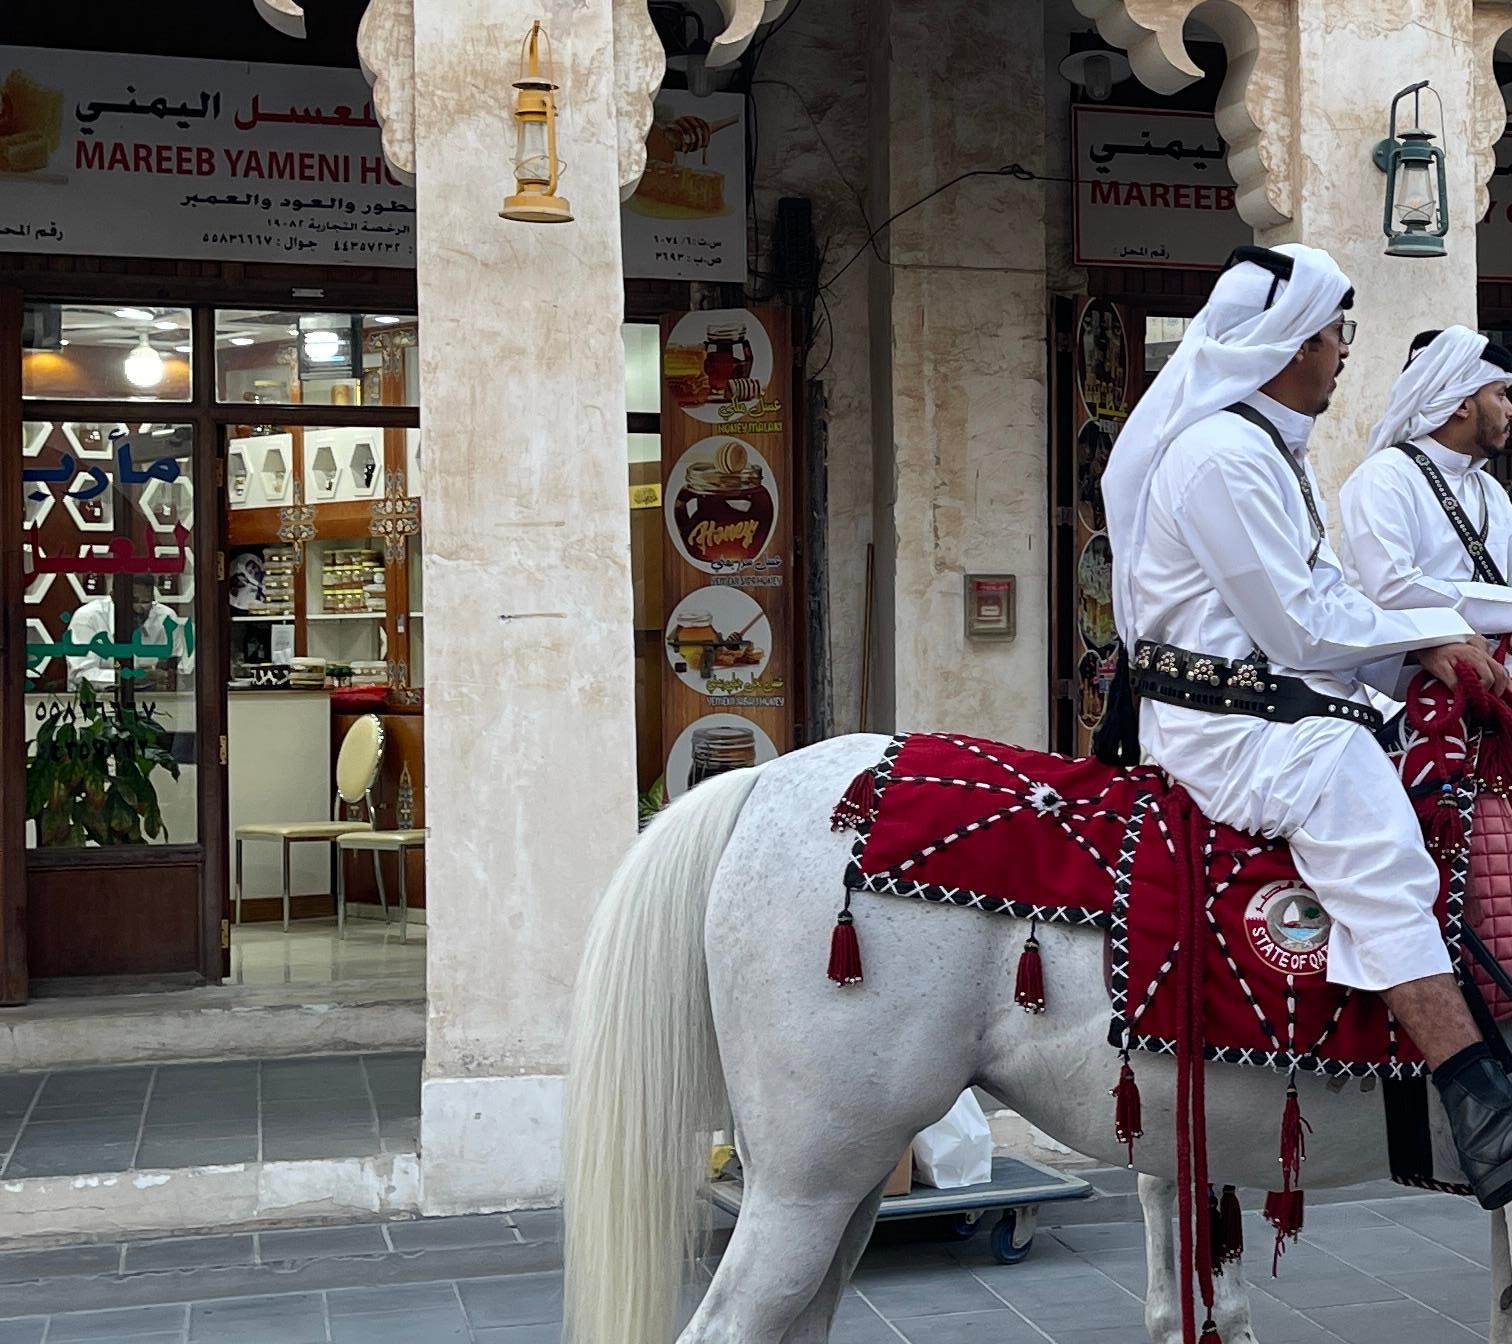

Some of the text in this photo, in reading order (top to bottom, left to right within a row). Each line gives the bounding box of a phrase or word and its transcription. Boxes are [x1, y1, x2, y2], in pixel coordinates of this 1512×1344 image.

[75, 85, 221, 135] اليمني
[75, 139, 216, 177] MAREEB
[223, 148, 350, 183] YAMENI
[1090, 180, 1236, 211] MAREEB
[35, 221, 64, 241] رقم
[687, 519, 760, 556] Honey
[1252, 926, 1291, 969] STATE
[1290, 953, 1308, 970] OF
